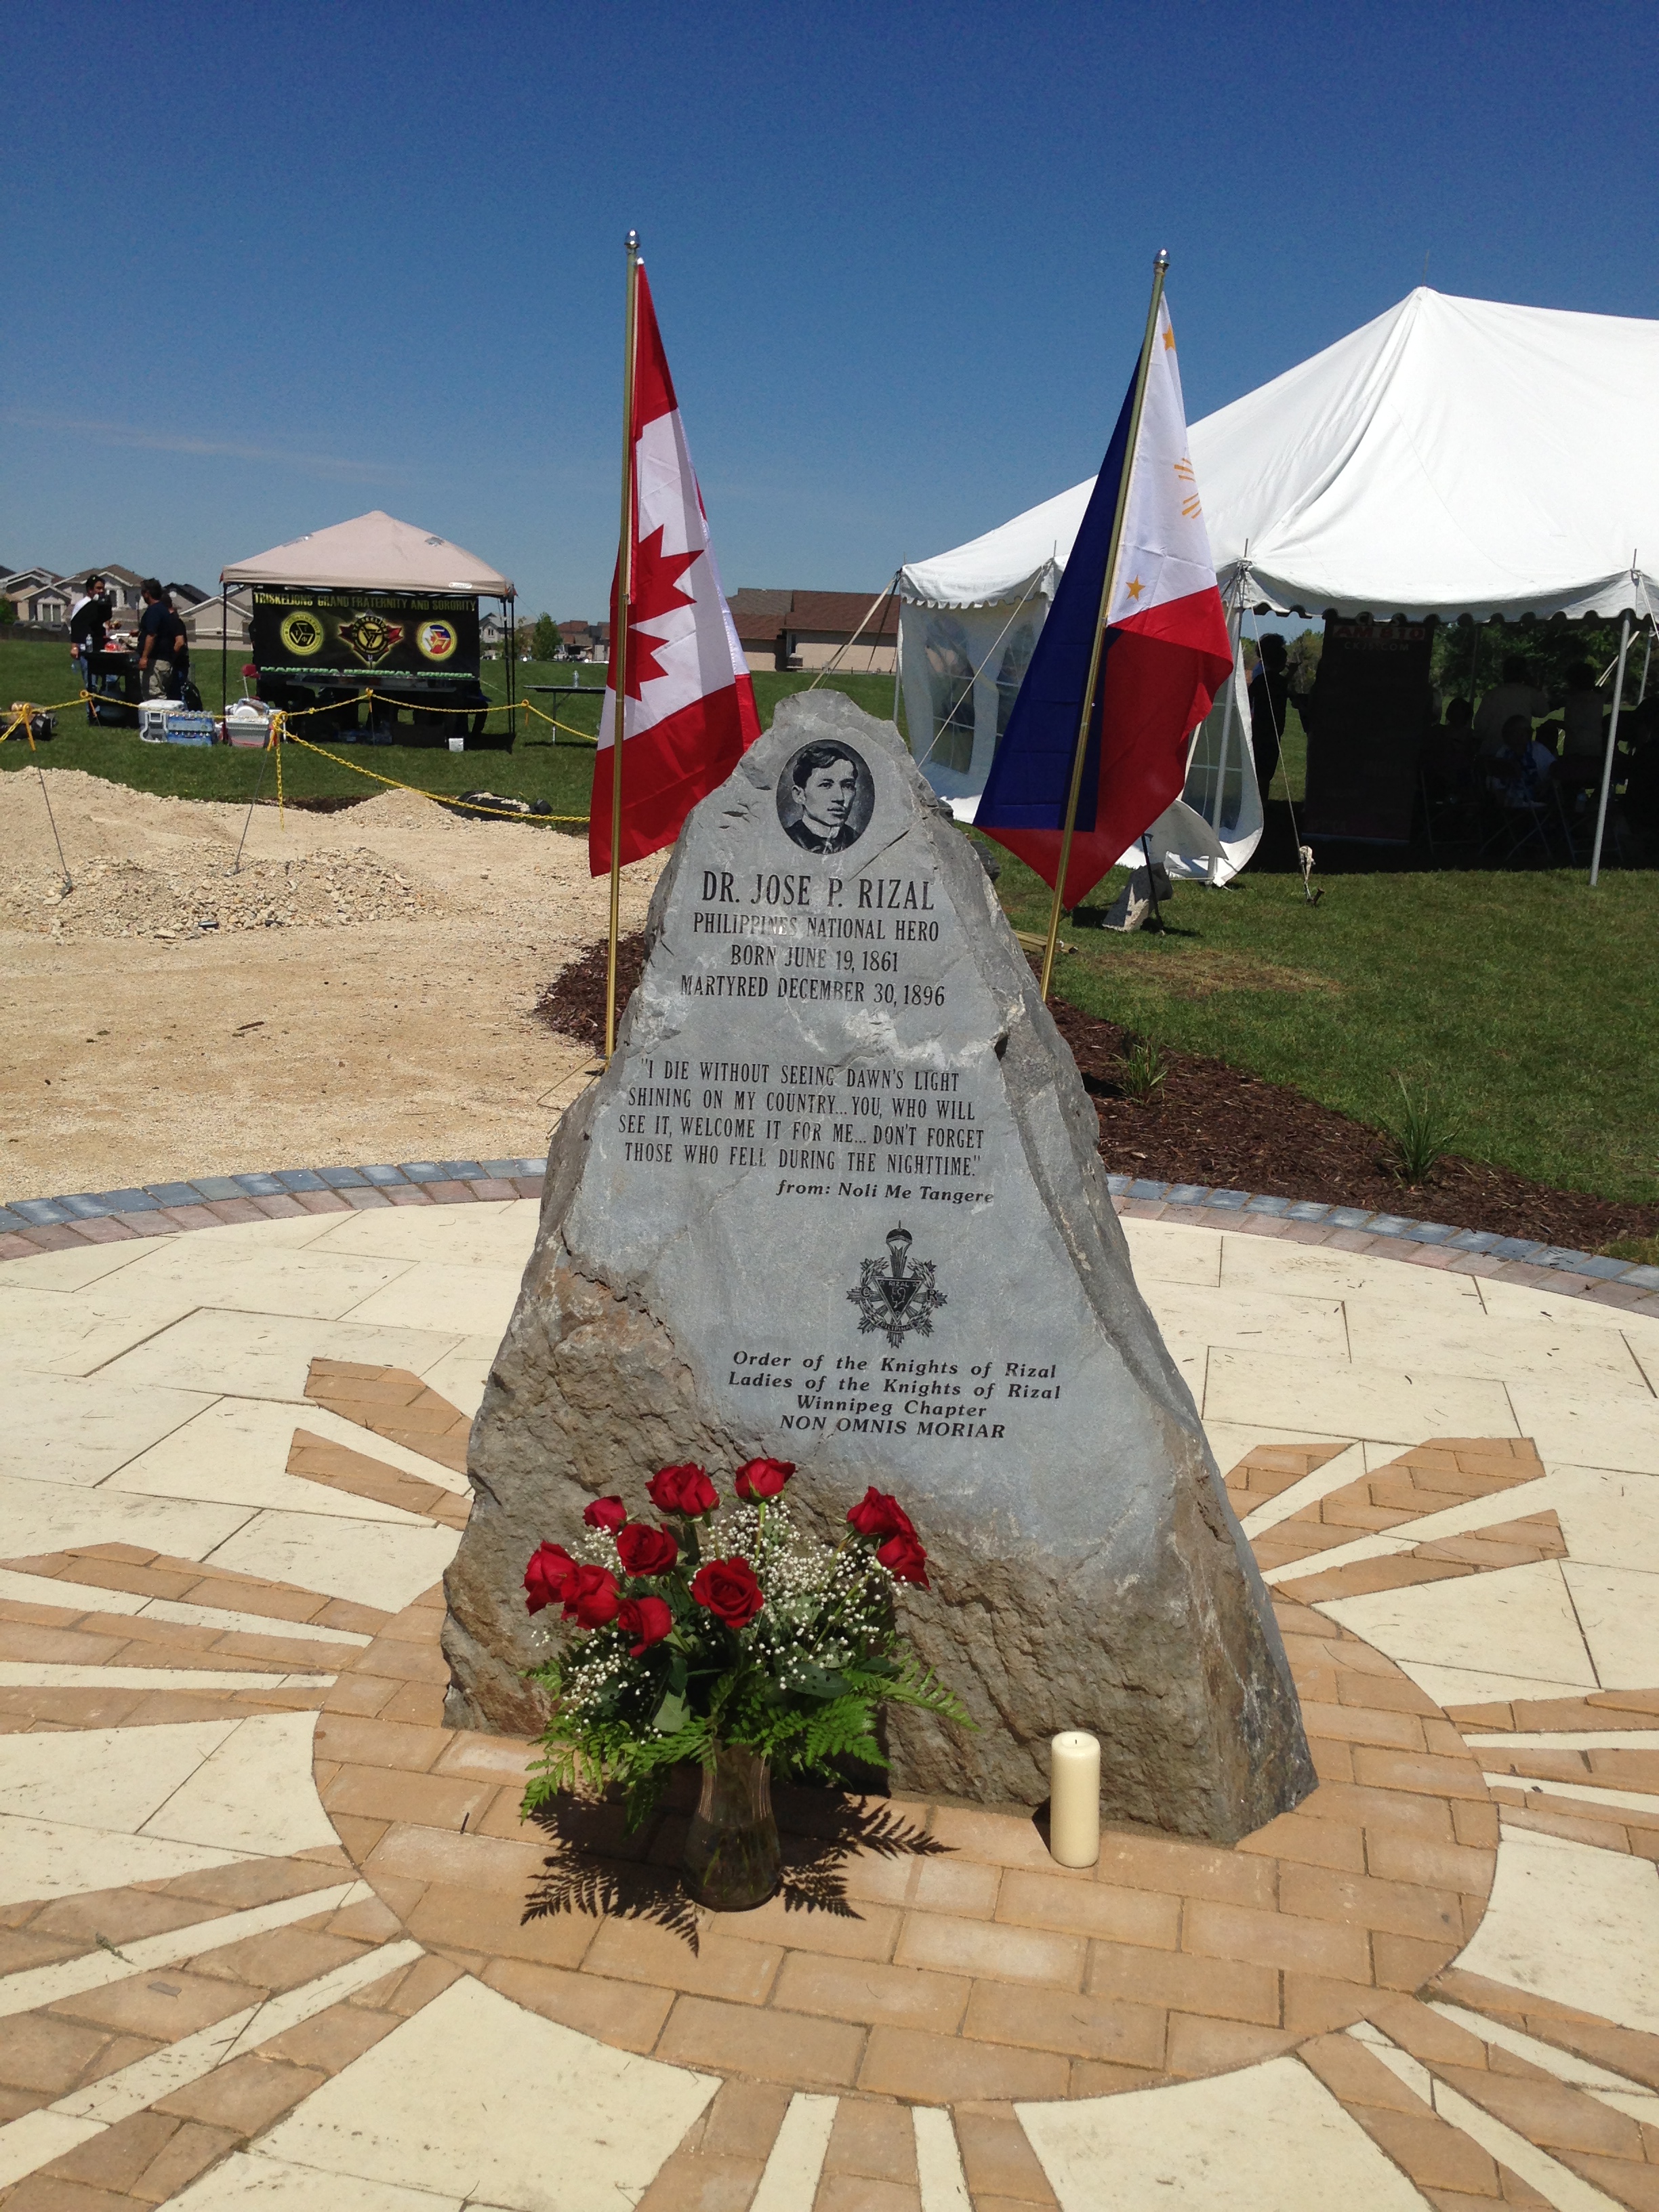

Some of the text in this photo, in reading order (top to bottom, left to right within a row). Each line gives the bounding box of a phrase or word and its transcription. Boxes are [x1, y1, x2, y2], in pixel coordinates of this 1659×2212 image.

[318, 595, 348, 607] GRAND
[352, 596, 407, 609] FRATERNITY
[411, 600, 430, 610] AND
[432, 600, 476, 611] SORORITY
[1334, 626, 1425, 640] AM 810
[702, 871, 934, 910] DR. JOSE P. RIZAL
[694, 912, 939, 941] PHILIPPINES NATIONAL HERO
[731, 945, 898, 973] BORN JUNE 19, 1861
[681, 975, 945, 1007] MARTYRED DECEMBER 30, 1896
[641, 1058, 959, 1092] "I DIE WITHOUT SEEING DAWN'S LIGHT
[628, 1087, 975, 1120] SHINING ON MY COUNTRY... YOU, WHO WILL
[618, 1114, 984, 1149] SEE IT, WELCOME IT FOR ME... DON'T FORGET
[625, 1142, 981, 1176] THOSE WHO FELL DURING THE NIGHTTIME."
[777, 1179, 994, 1204] from: Noli Me Tangere
[880, 1322, 914, 1331] PILIPINAS
[733, 1351, 1057, 1380] Order of the Knights of Rizal
[729, 1372, 1061, 1400] Ladies of the Knights of Rizal
[797, 1394, 987, 1420] Winnipeg Chapter
[780, 1415, 1006, 1439] NON OMNIS MORIAR
